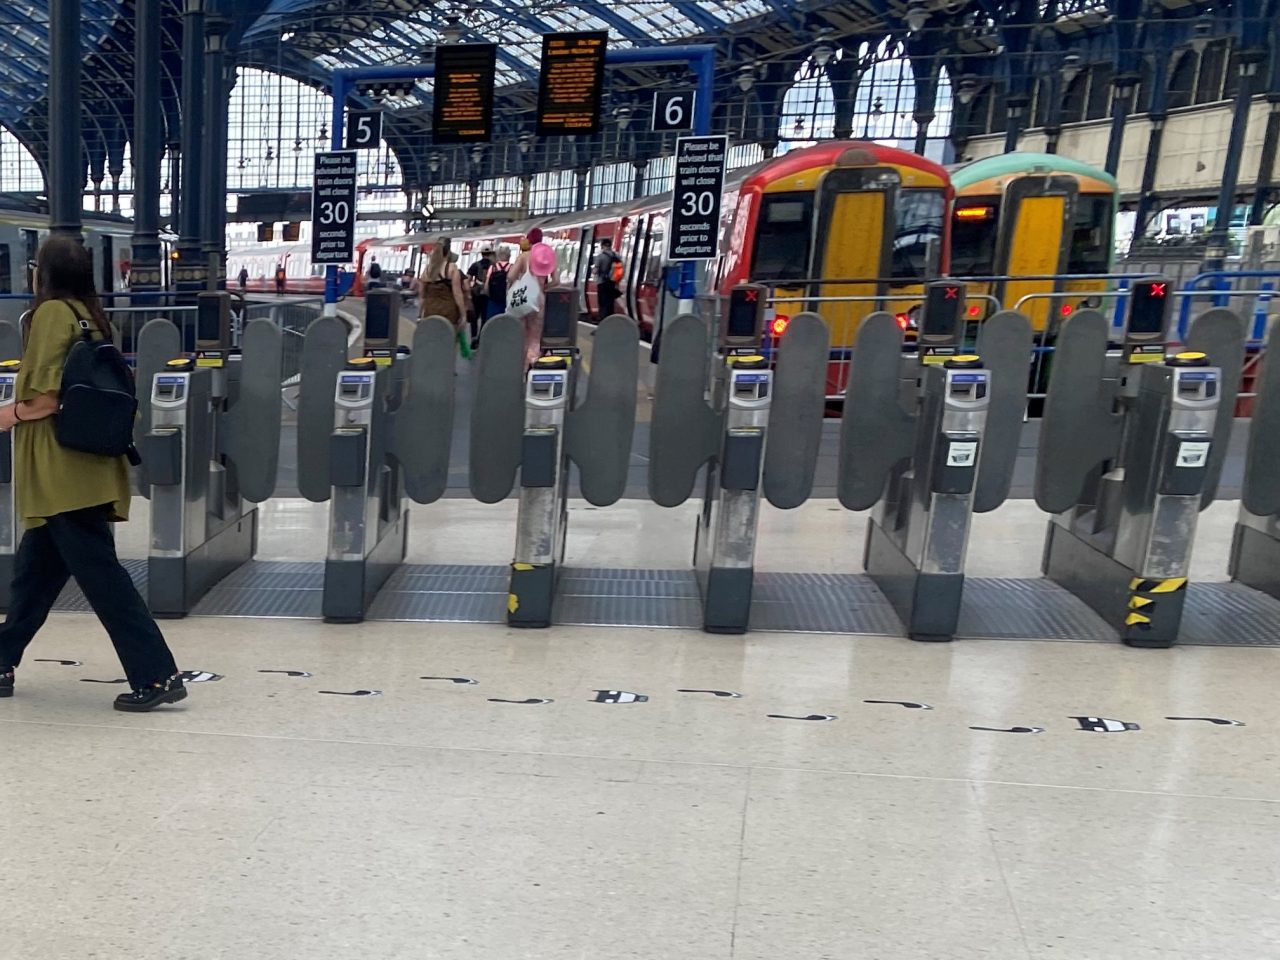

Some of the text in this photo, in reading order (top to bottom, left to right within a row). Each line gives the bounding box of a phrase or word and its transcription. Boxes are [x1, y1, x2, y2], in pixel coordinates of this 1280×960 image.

[665, 96, 683, 125] 6
[356, 117, 371, 143] 5
[684, 141, 719, 151] Please be
[320, 156, 341, 164] Please
[679, 153, 723, 163] advised that
[680, 165, 720, 175] train doors
[681, 176, 716, 186] will close
[681, 191, 714, 216] 30
[320, 201, 349, 224] 30
[680, 222, 710, 232] seconds
[320, 230, 346, 238] seconds
[680, 234, 708, 244] prior to
[321, 241, 337, 250] prior
[675, 245, 712, 255] departure
[317, 251, 349, 260] departure
